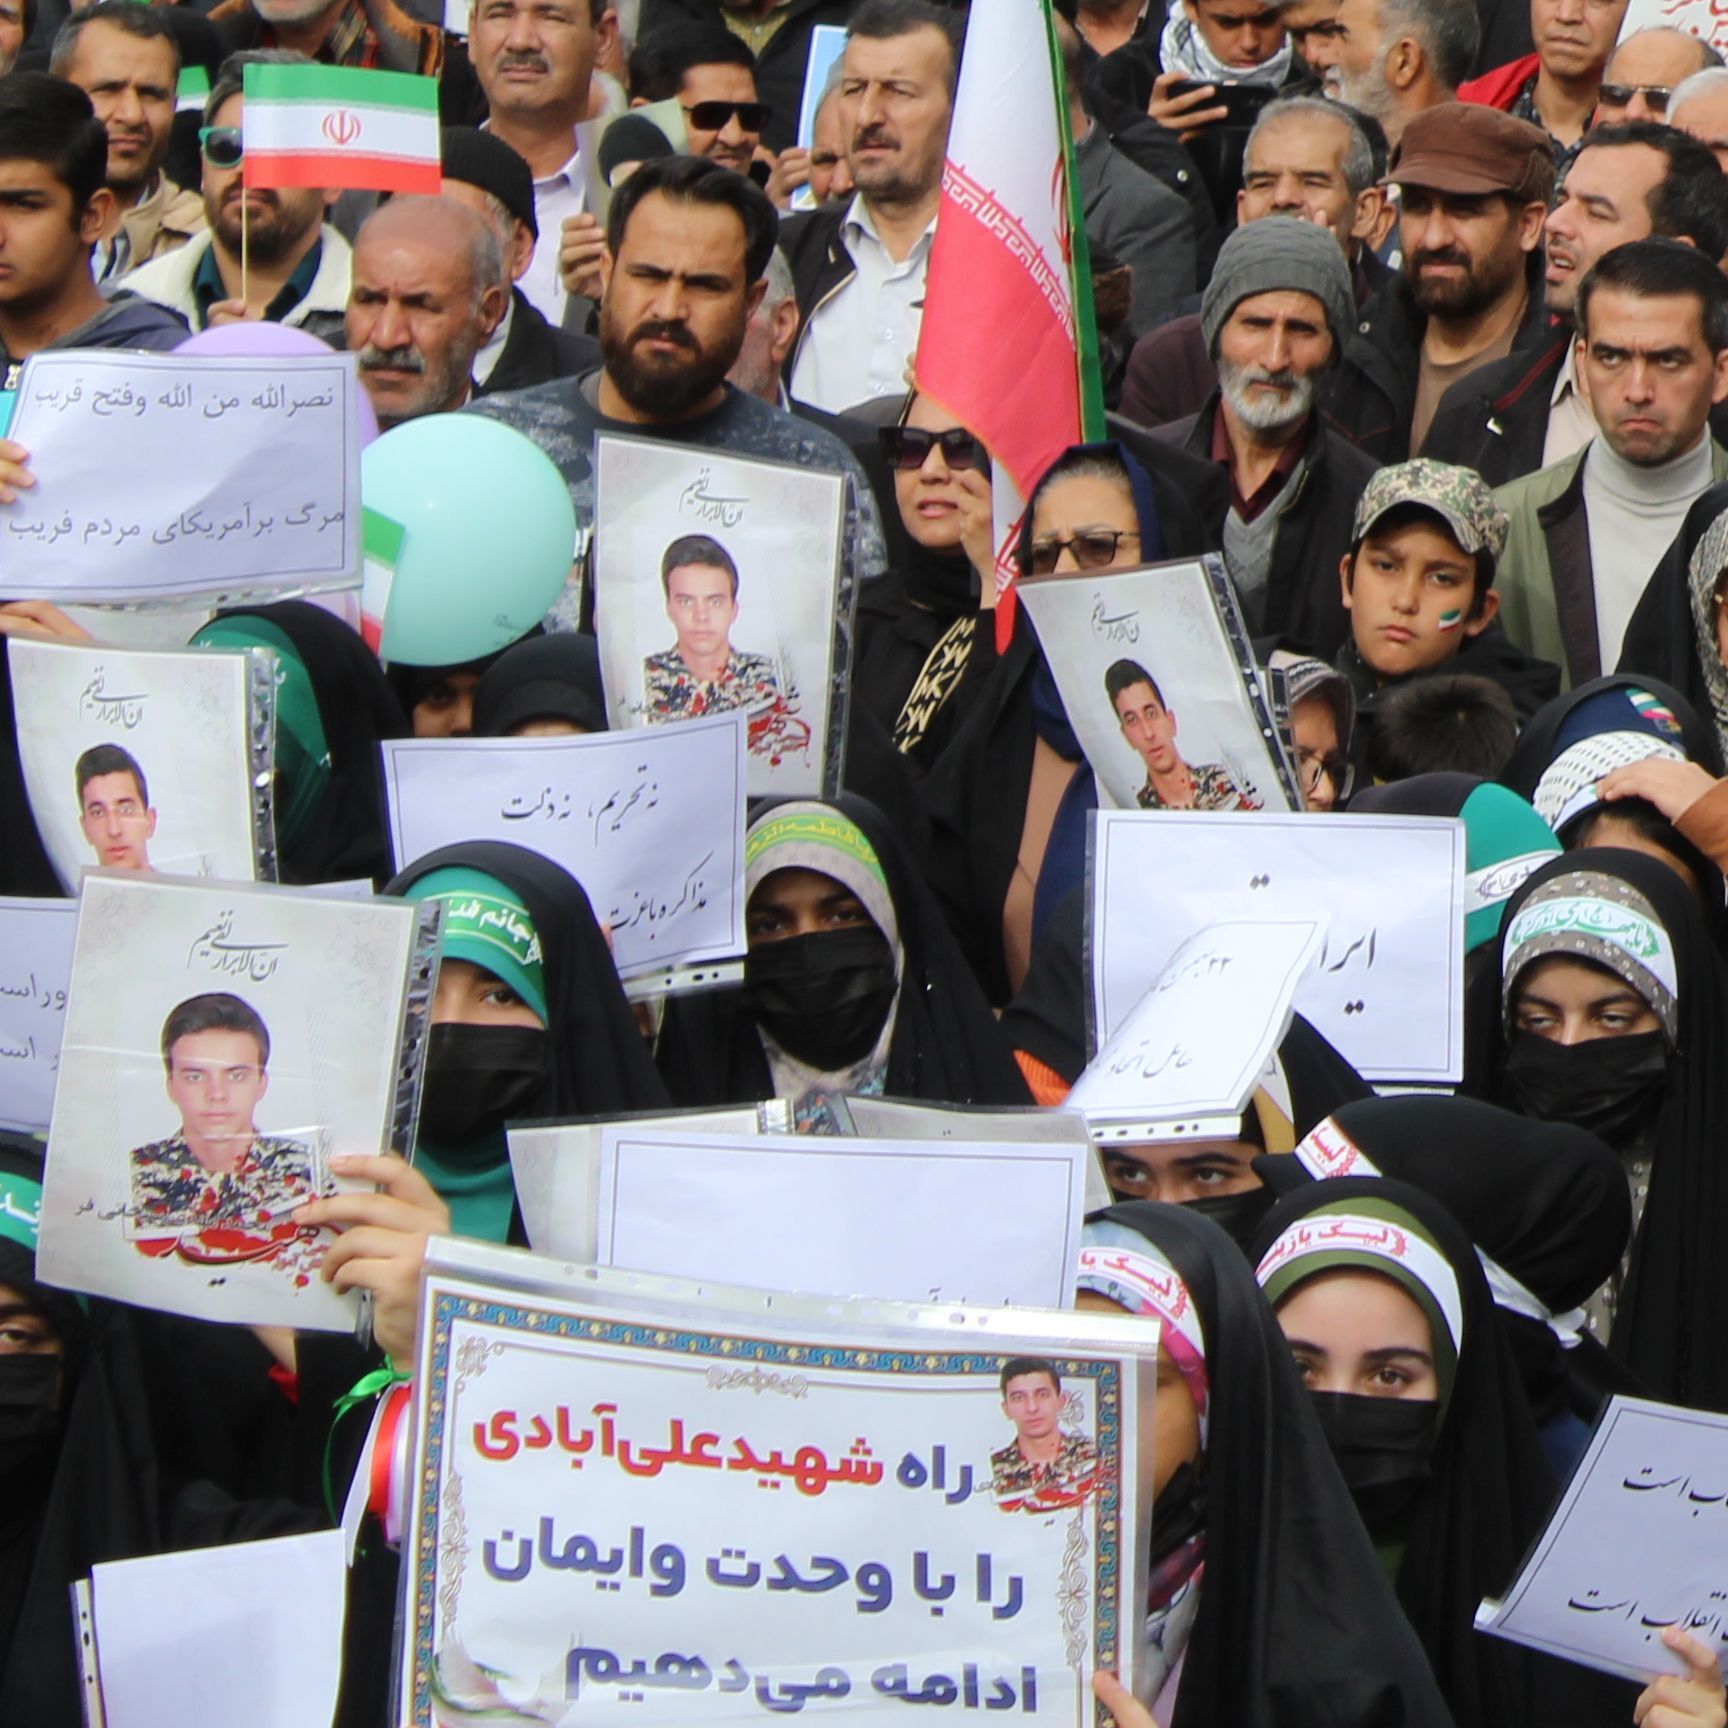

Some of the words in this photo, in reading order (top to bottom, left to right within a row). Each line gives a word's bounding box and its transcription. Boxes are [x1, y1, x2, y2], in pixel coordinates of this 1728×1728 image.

[34, 379, 83, 412] قریب
[158, 384, 192, 410] الله
[203, 392, 240, 419] من
[8, 509, 73, 542] فریب
[83, 517, 141, 545] مردم
[284, 502, 345, 532] مرگ
[896, 1444, 974, 1505] راه
[1621, 1467, 1687, 1496] است
[705, 1546, 894, 1613] وحدت
[911, 1549, 957, 1617] با
[975, 1550, 1025, 1619] را
[1567, 1589, 1639, 1621] است
[871, 1661, 1038, 1713] ادامه
